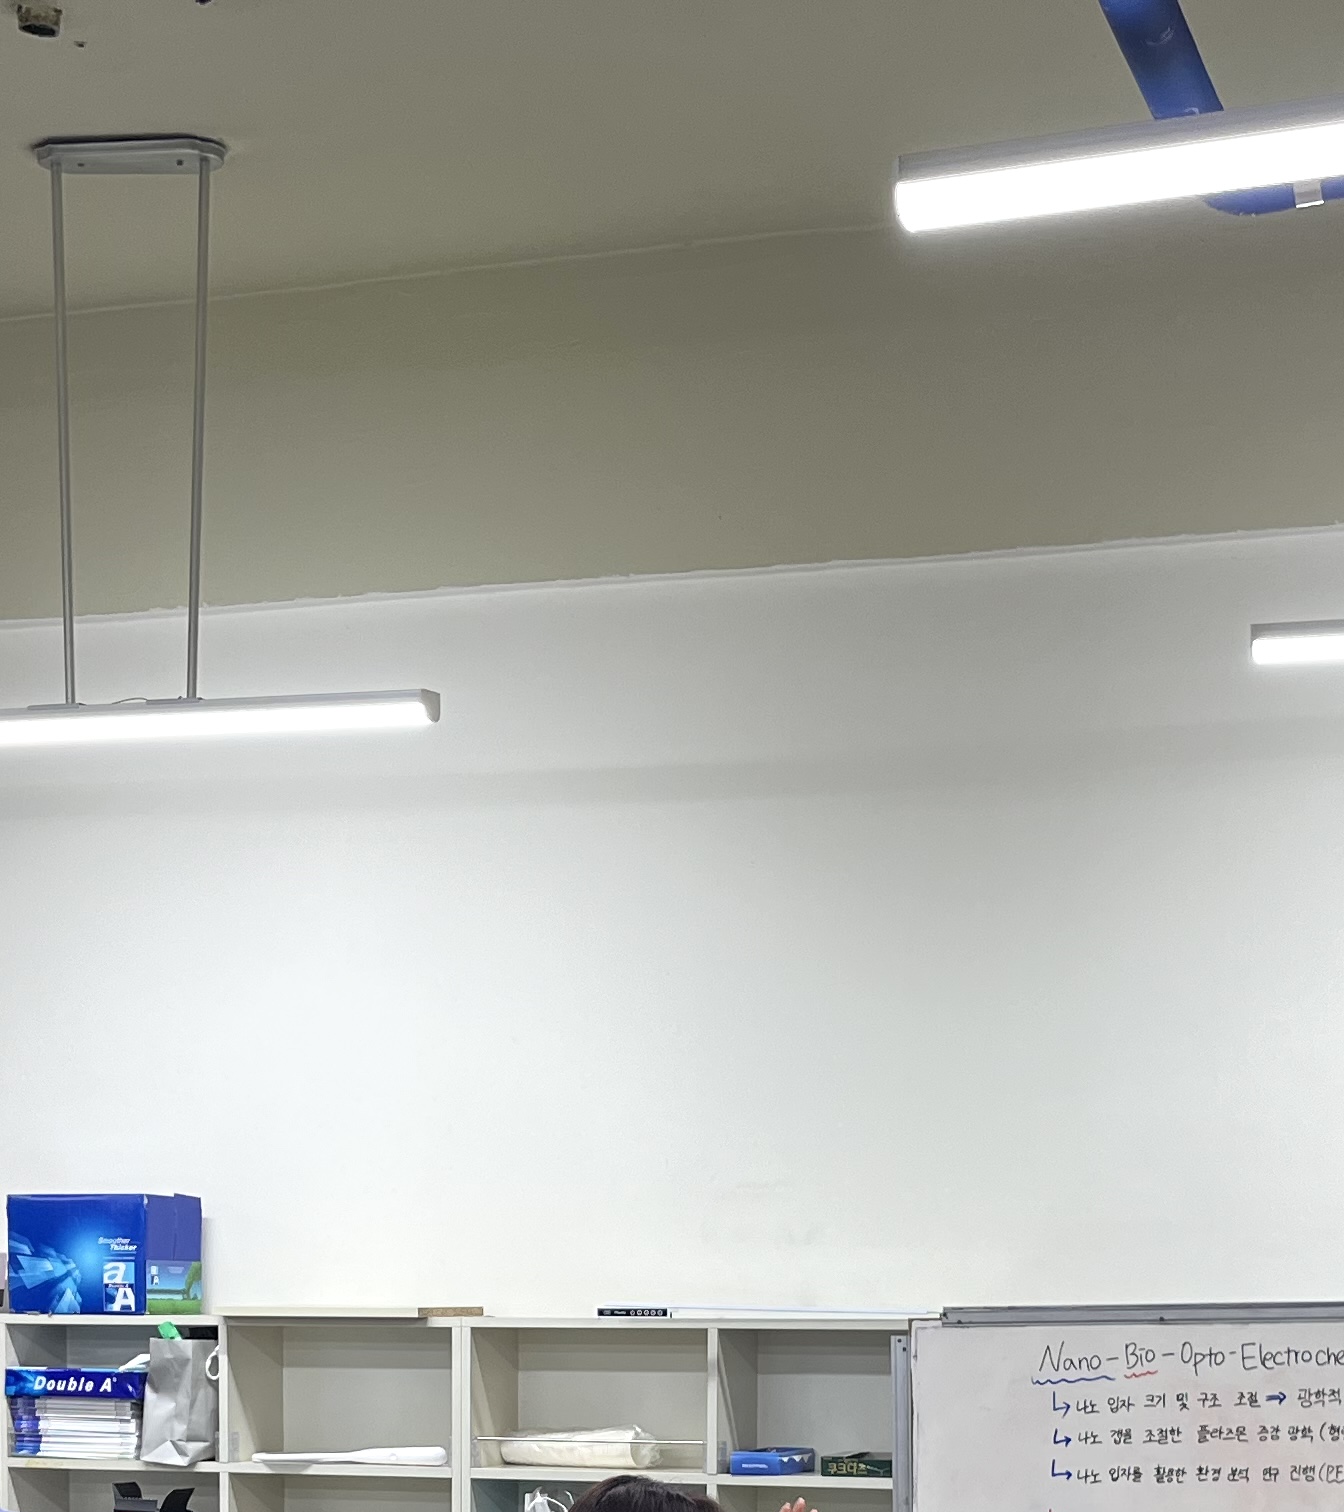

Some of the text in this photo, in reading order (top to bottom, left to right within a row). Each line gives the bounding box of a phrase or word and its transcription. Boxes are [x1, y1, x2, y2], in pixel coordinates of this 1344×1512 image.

[33, 1376, 94, 1393] Double
[1076, 1398, 1100, 1414] 나노
[1108, 1395, 1135, 1414] 입자
[1144, 1393, 1167, 1409] 크기
[1176, 1392, 1190, 1411] 및
[1197, 1391, 1223, 1408] 구조
[1234, 1390, 1261, 1408] 조절
[1297, 1386, 1342, 1409] 광학적
[1078, 1430, 1103, 1446] 나노
[1142, 1426, 1183, 1444] 조절한
[1076, 1468, 1100, 1485] 나노
